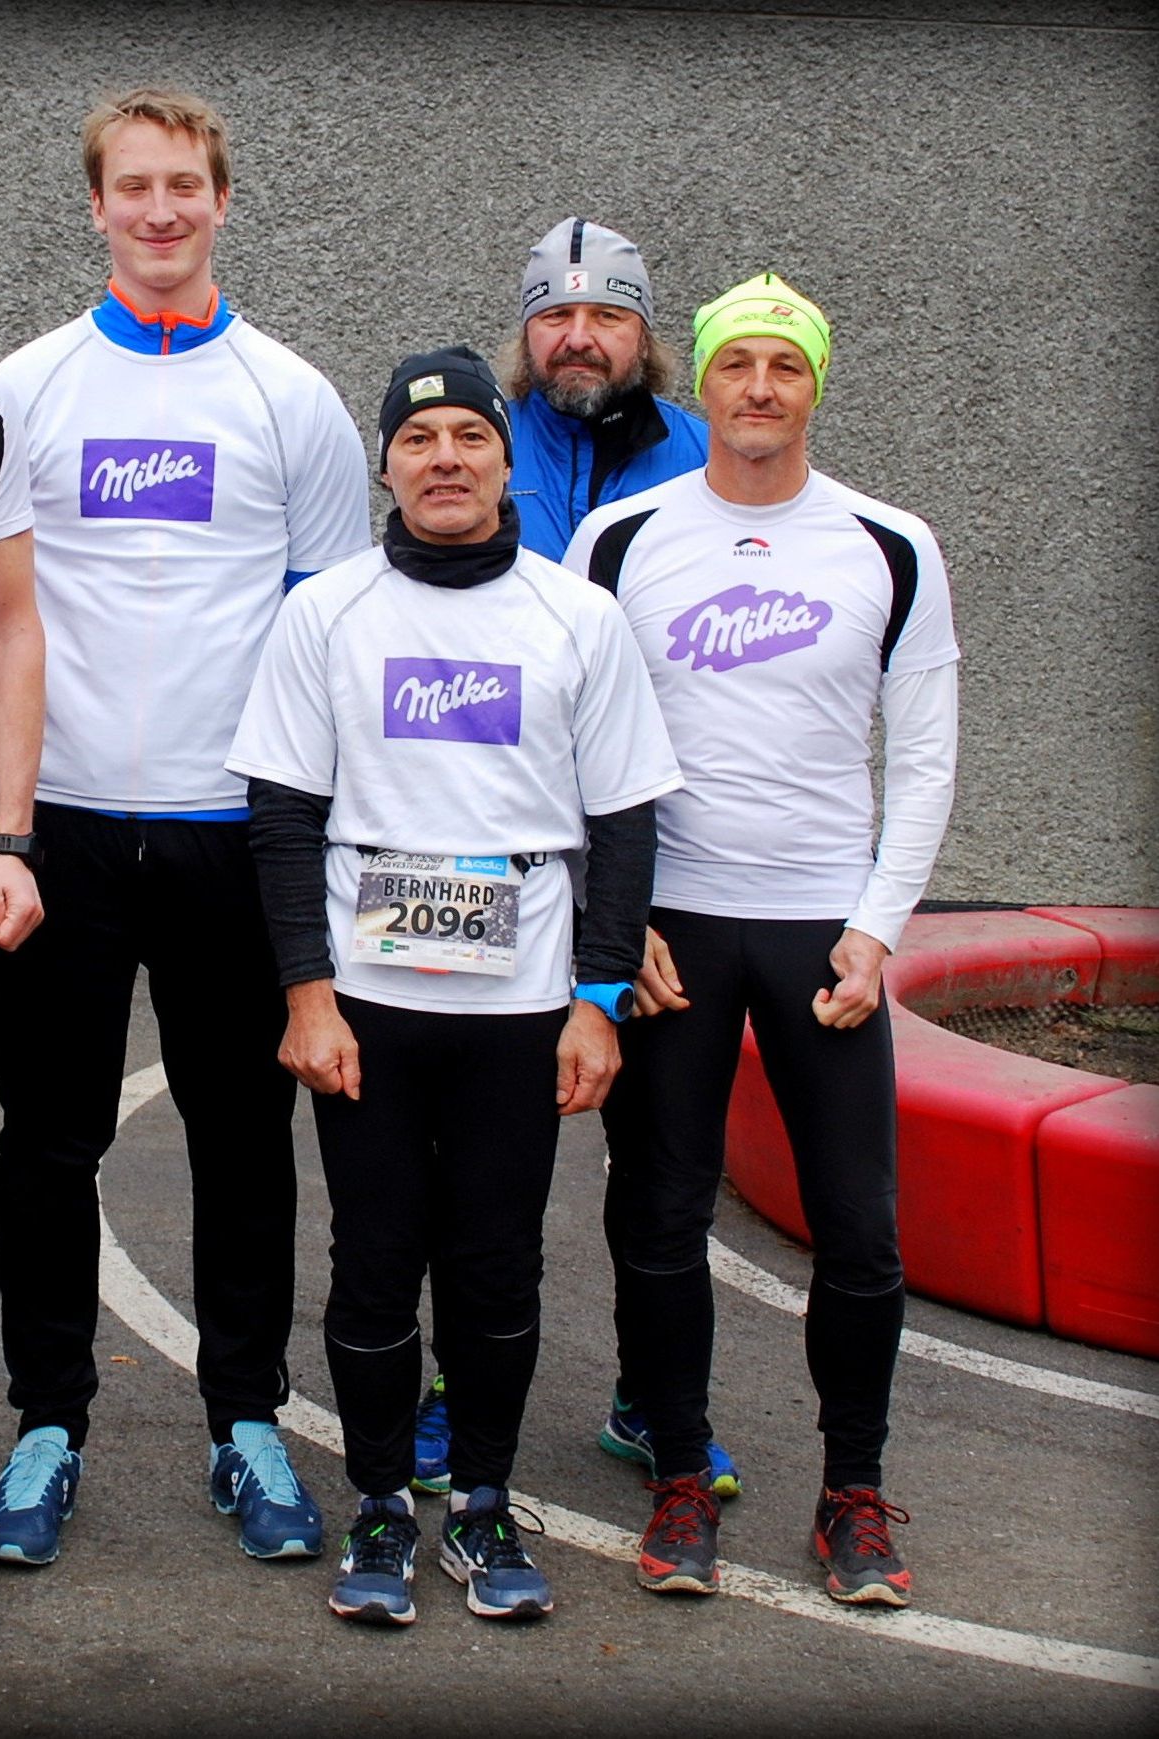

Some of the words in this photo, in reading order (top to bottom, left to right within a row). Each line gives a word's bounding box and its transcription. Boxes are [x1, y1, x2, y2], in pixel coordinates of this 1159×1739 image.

[89, 448, 203, 503] Milka
[732, 548, 772, 558] skinfit
[688, 598, 821, 658] Milka
[393, 670, 509, 724] Milka
[384, 878, 495, 906] BERNHARD
[386, 902, 486, 940] 2096
